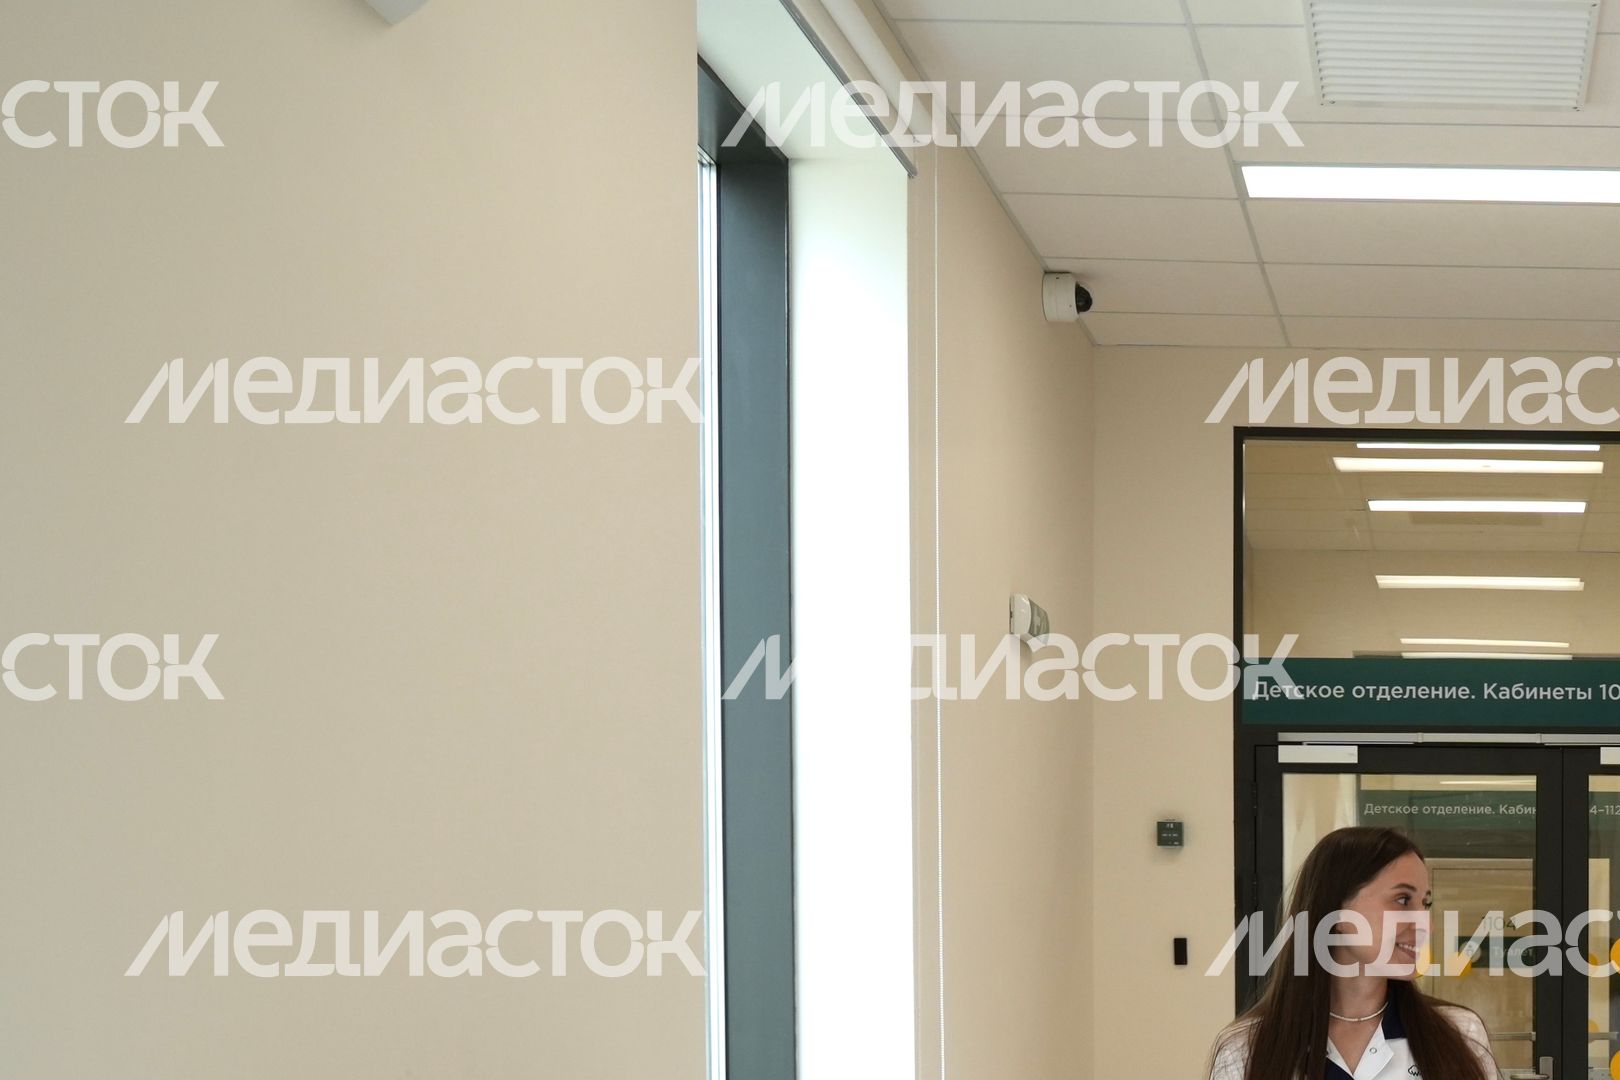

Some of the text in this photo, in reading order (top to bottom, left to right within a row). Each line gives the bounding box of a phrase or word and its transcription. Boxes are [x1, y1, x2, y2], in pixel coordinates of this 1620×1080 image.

[1252, 680, 1345, 700] Детское
[1352, 684, 1476, 700] отделение.
[1483, 683, 1592, 700] Кабинеты
[1364, 803, 1419, 815] Детское
[1422, 804, 1496, 815] отделение.
